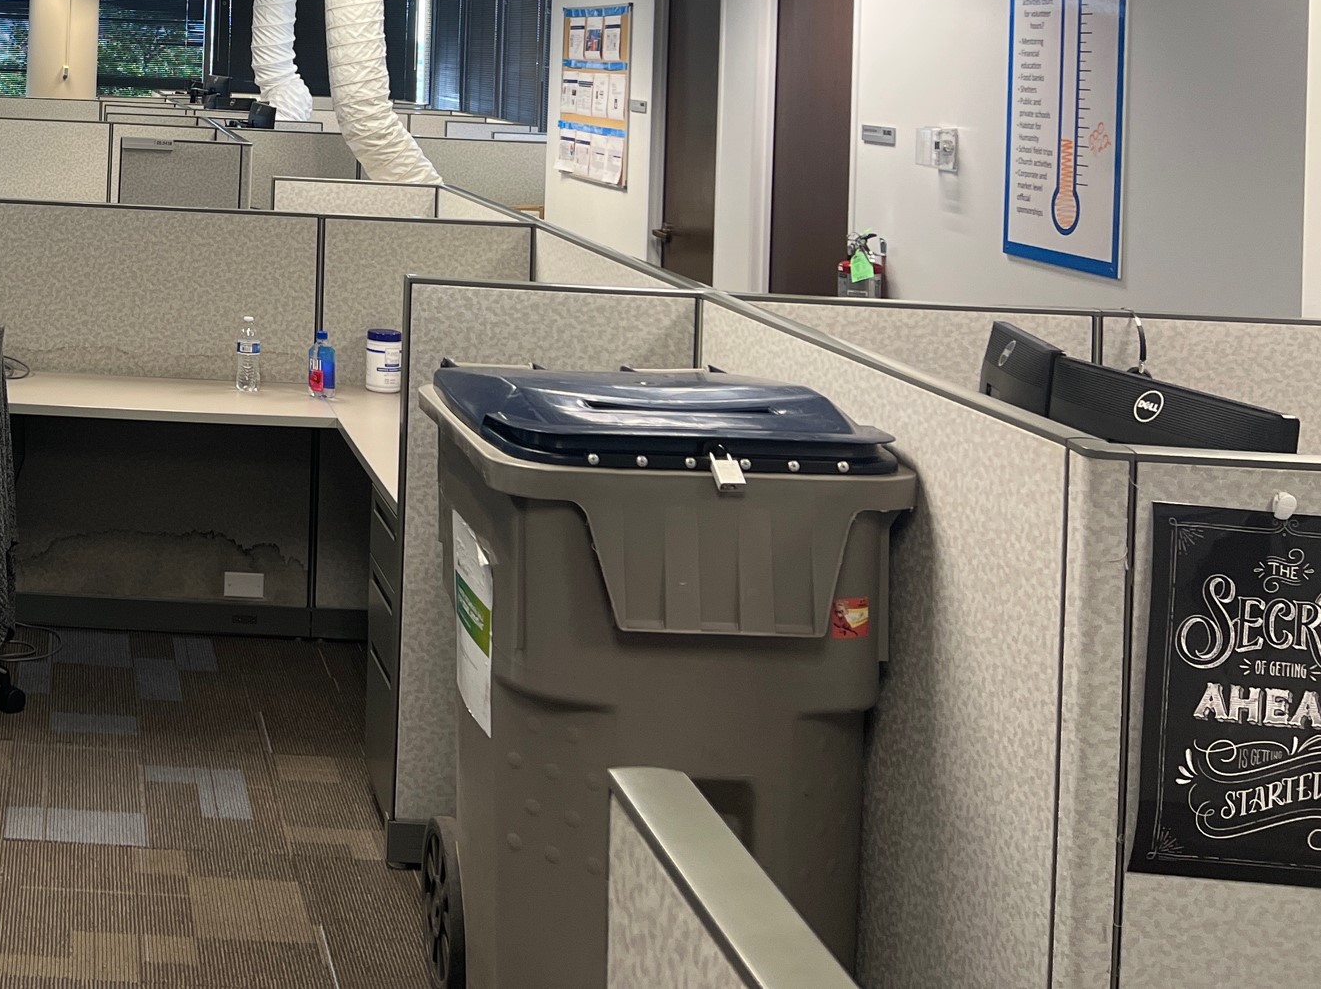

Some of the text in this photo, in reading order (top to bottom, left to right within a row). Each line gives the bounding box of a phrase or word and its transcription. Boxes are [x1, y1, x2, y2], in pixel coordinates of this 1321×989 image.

[1021, 38, 1044, 47] Mentoring
[309, 358, 322, 371] FIJI
[1137, 399, 1159, 412] DELL
[1267, 561, 1300, 580] THE
[1255, 660, 1308, 679] OF GETTING
[1238, 749, 1284, 769] IS GETTING
